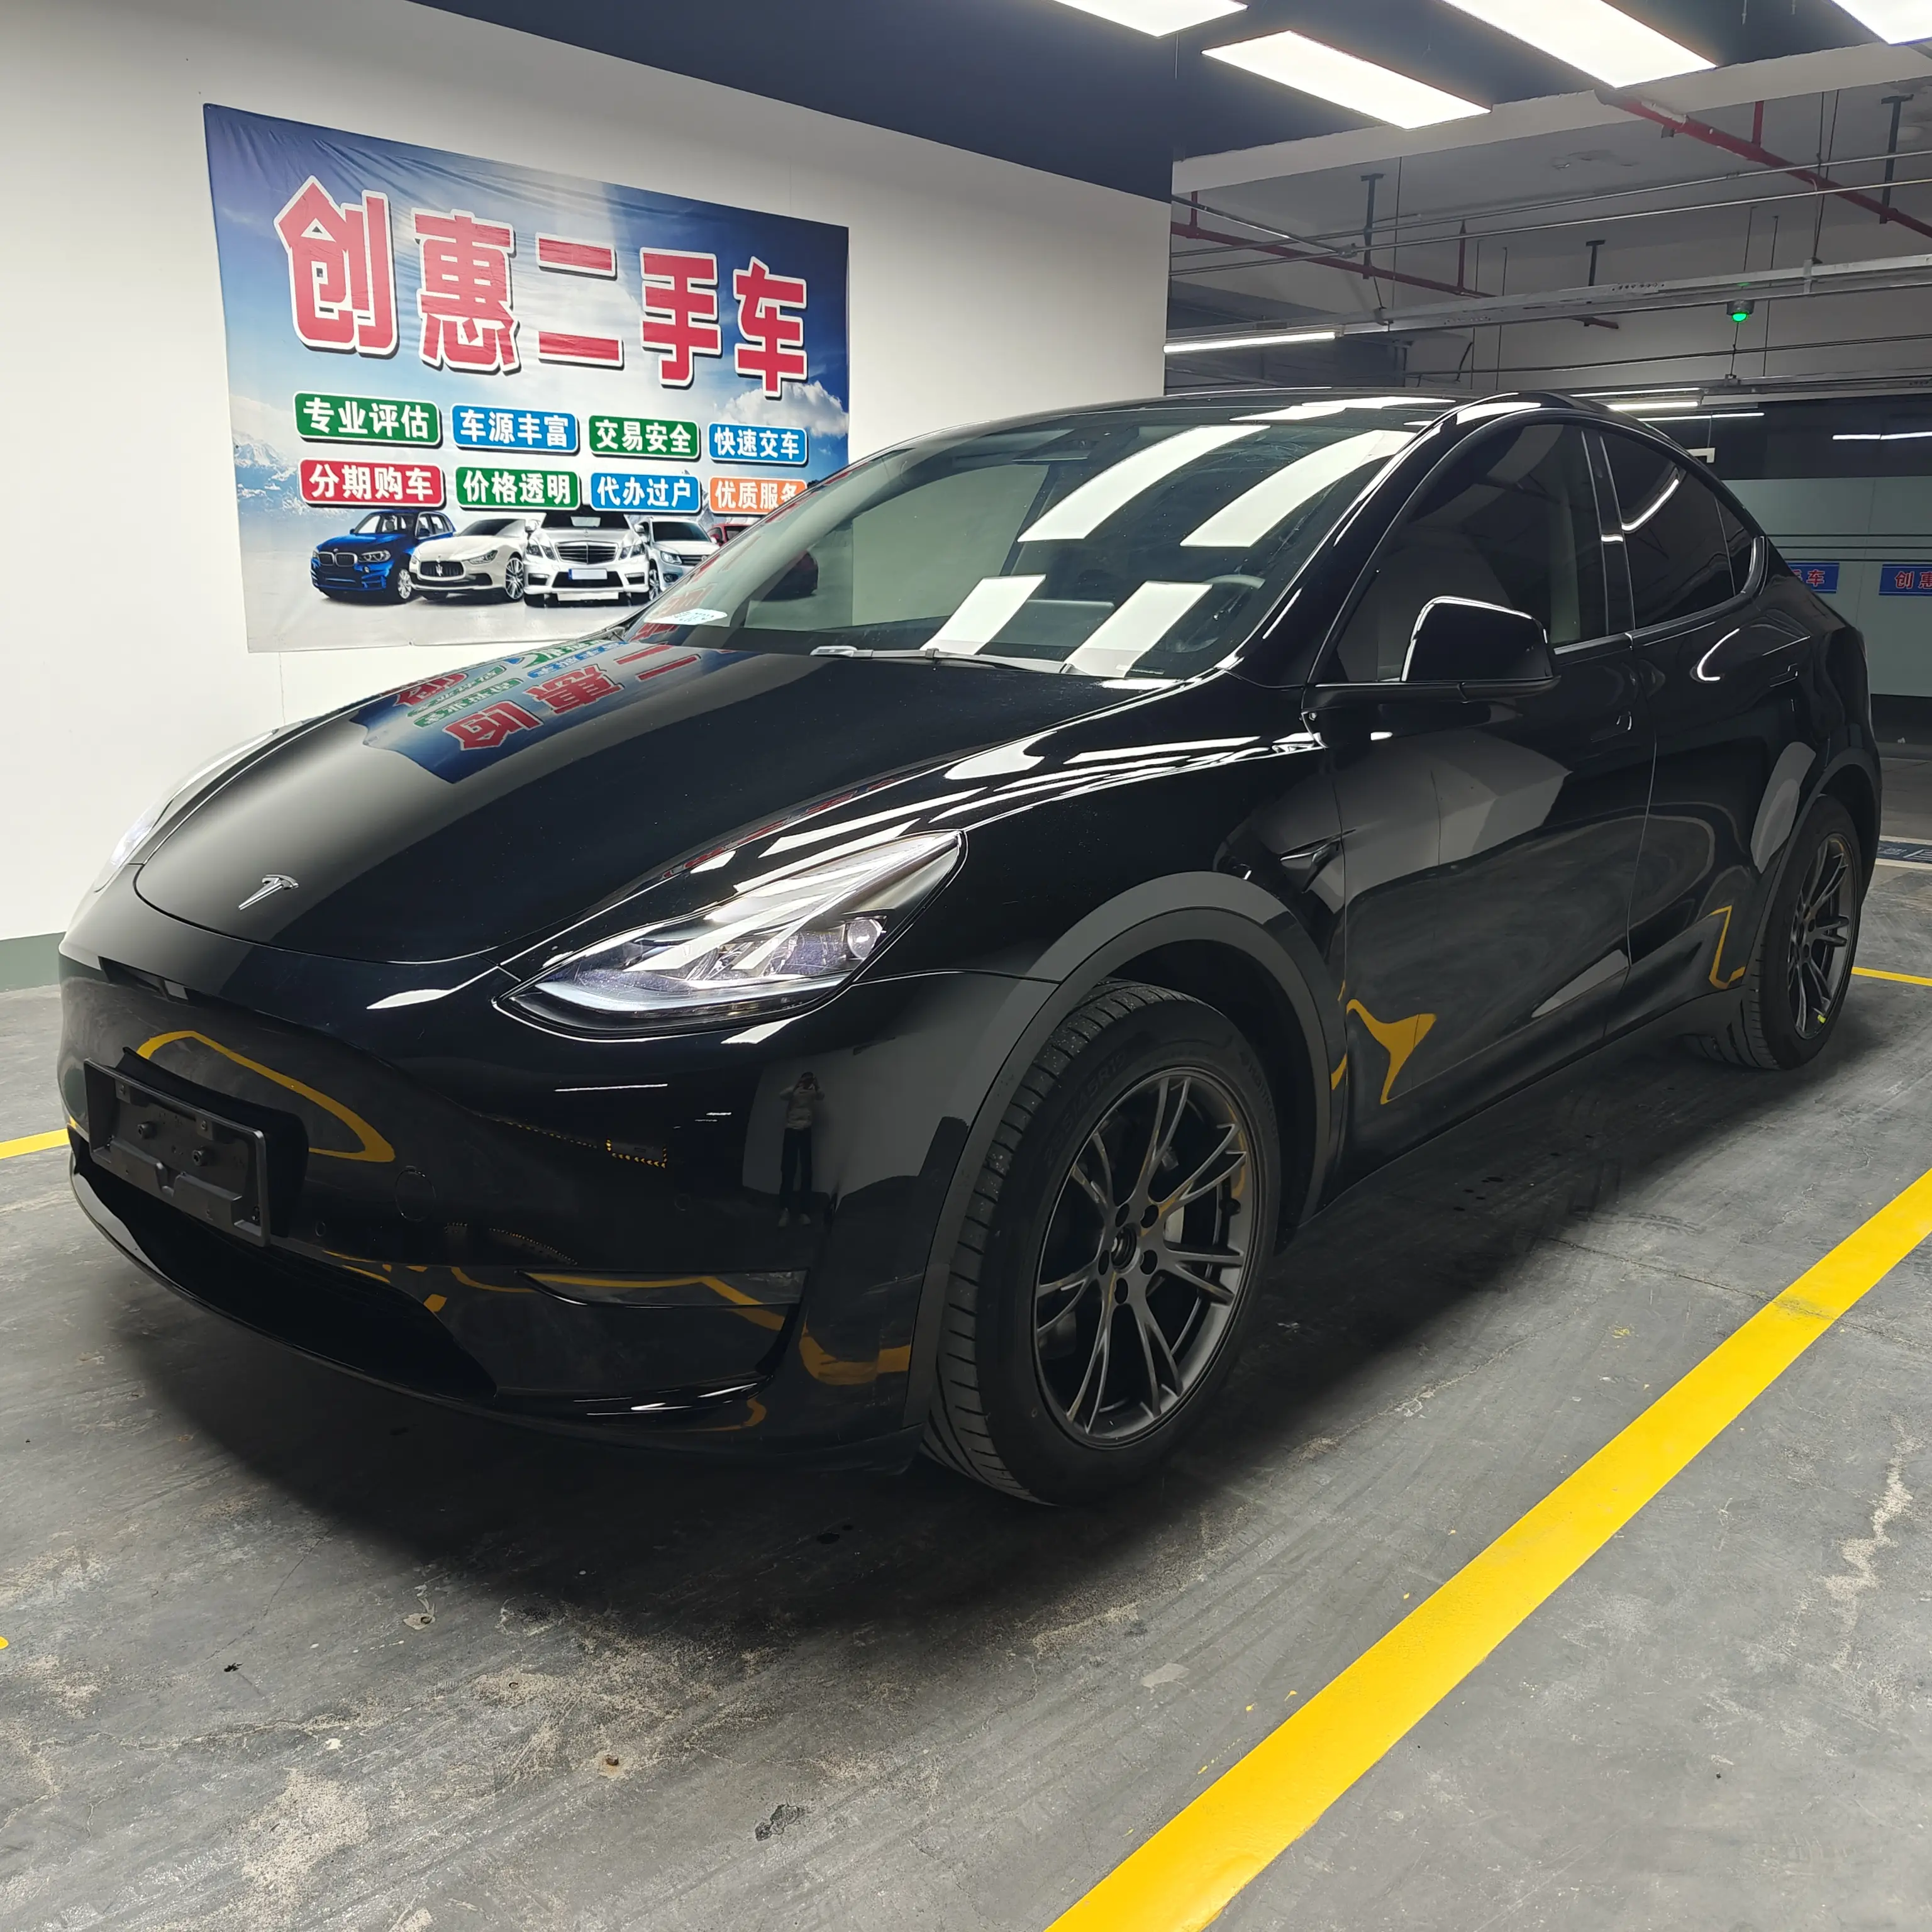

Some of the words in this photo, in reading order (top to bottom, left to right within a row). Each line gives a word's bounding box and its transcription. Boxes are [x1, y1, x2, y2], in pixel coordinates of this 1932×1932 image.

[274, 175, 808, 398] 创惠二手车
[303, 397, 429, 439] 专业评估
[460, 409, 569, 447] 车源丰富
[595, 419, 691, 453] 交易安全
[714, 426, 799, 460] 快速交车
[309, 464, 433, 502] 分期购车
[463, 470, 571, 504] 价格透明
[597, 475, 691, 508] 代办过户
